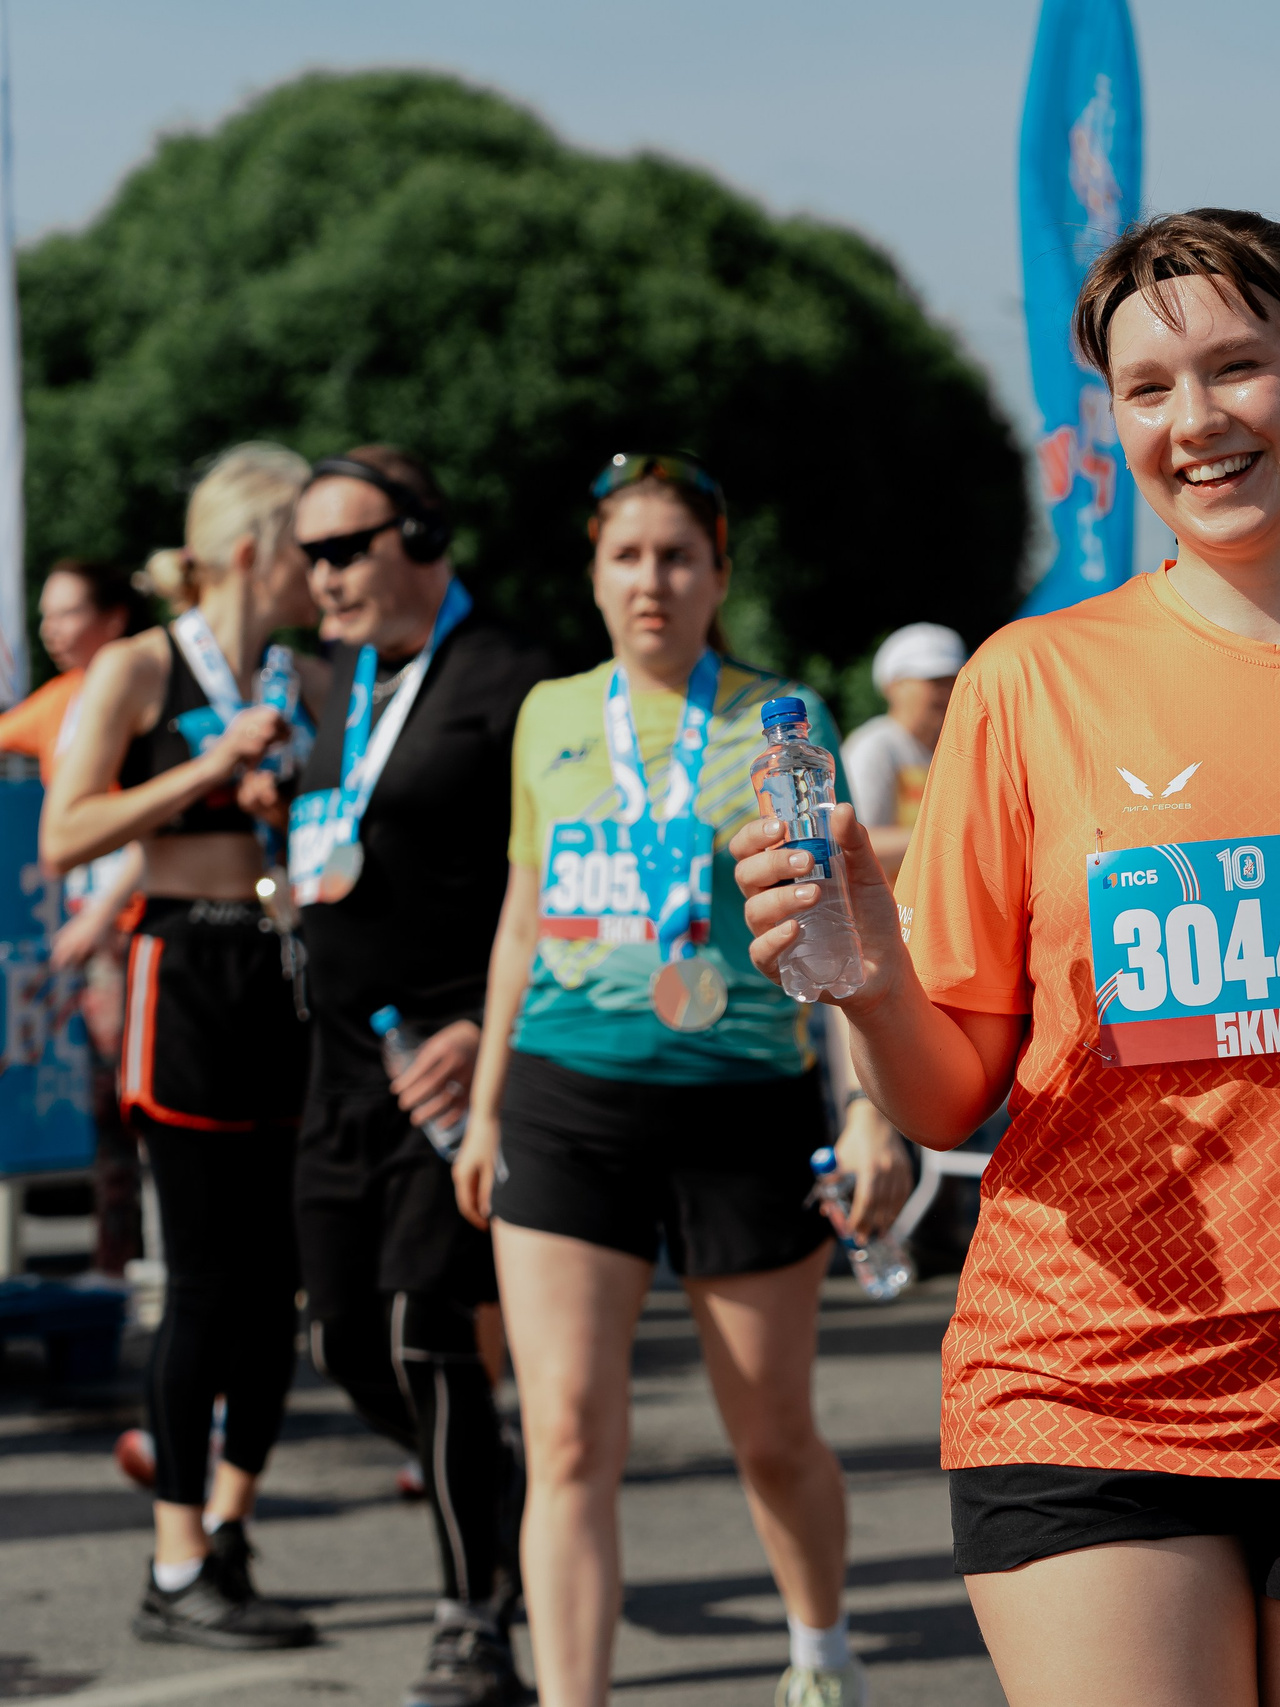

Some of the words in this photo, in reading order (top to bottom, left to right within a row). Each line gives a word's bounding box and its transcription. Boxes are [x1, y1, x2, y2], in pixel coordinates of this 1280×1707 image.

[1122, 805, 1149, 813] ЛИГА
[1152, 803, 1192, 811] ГЕРОЕВ
[550, 850, 650, 914] 305
[1121, 869, 1159, 887] ПСБ
[1215, 845, 1266, 891] 10
